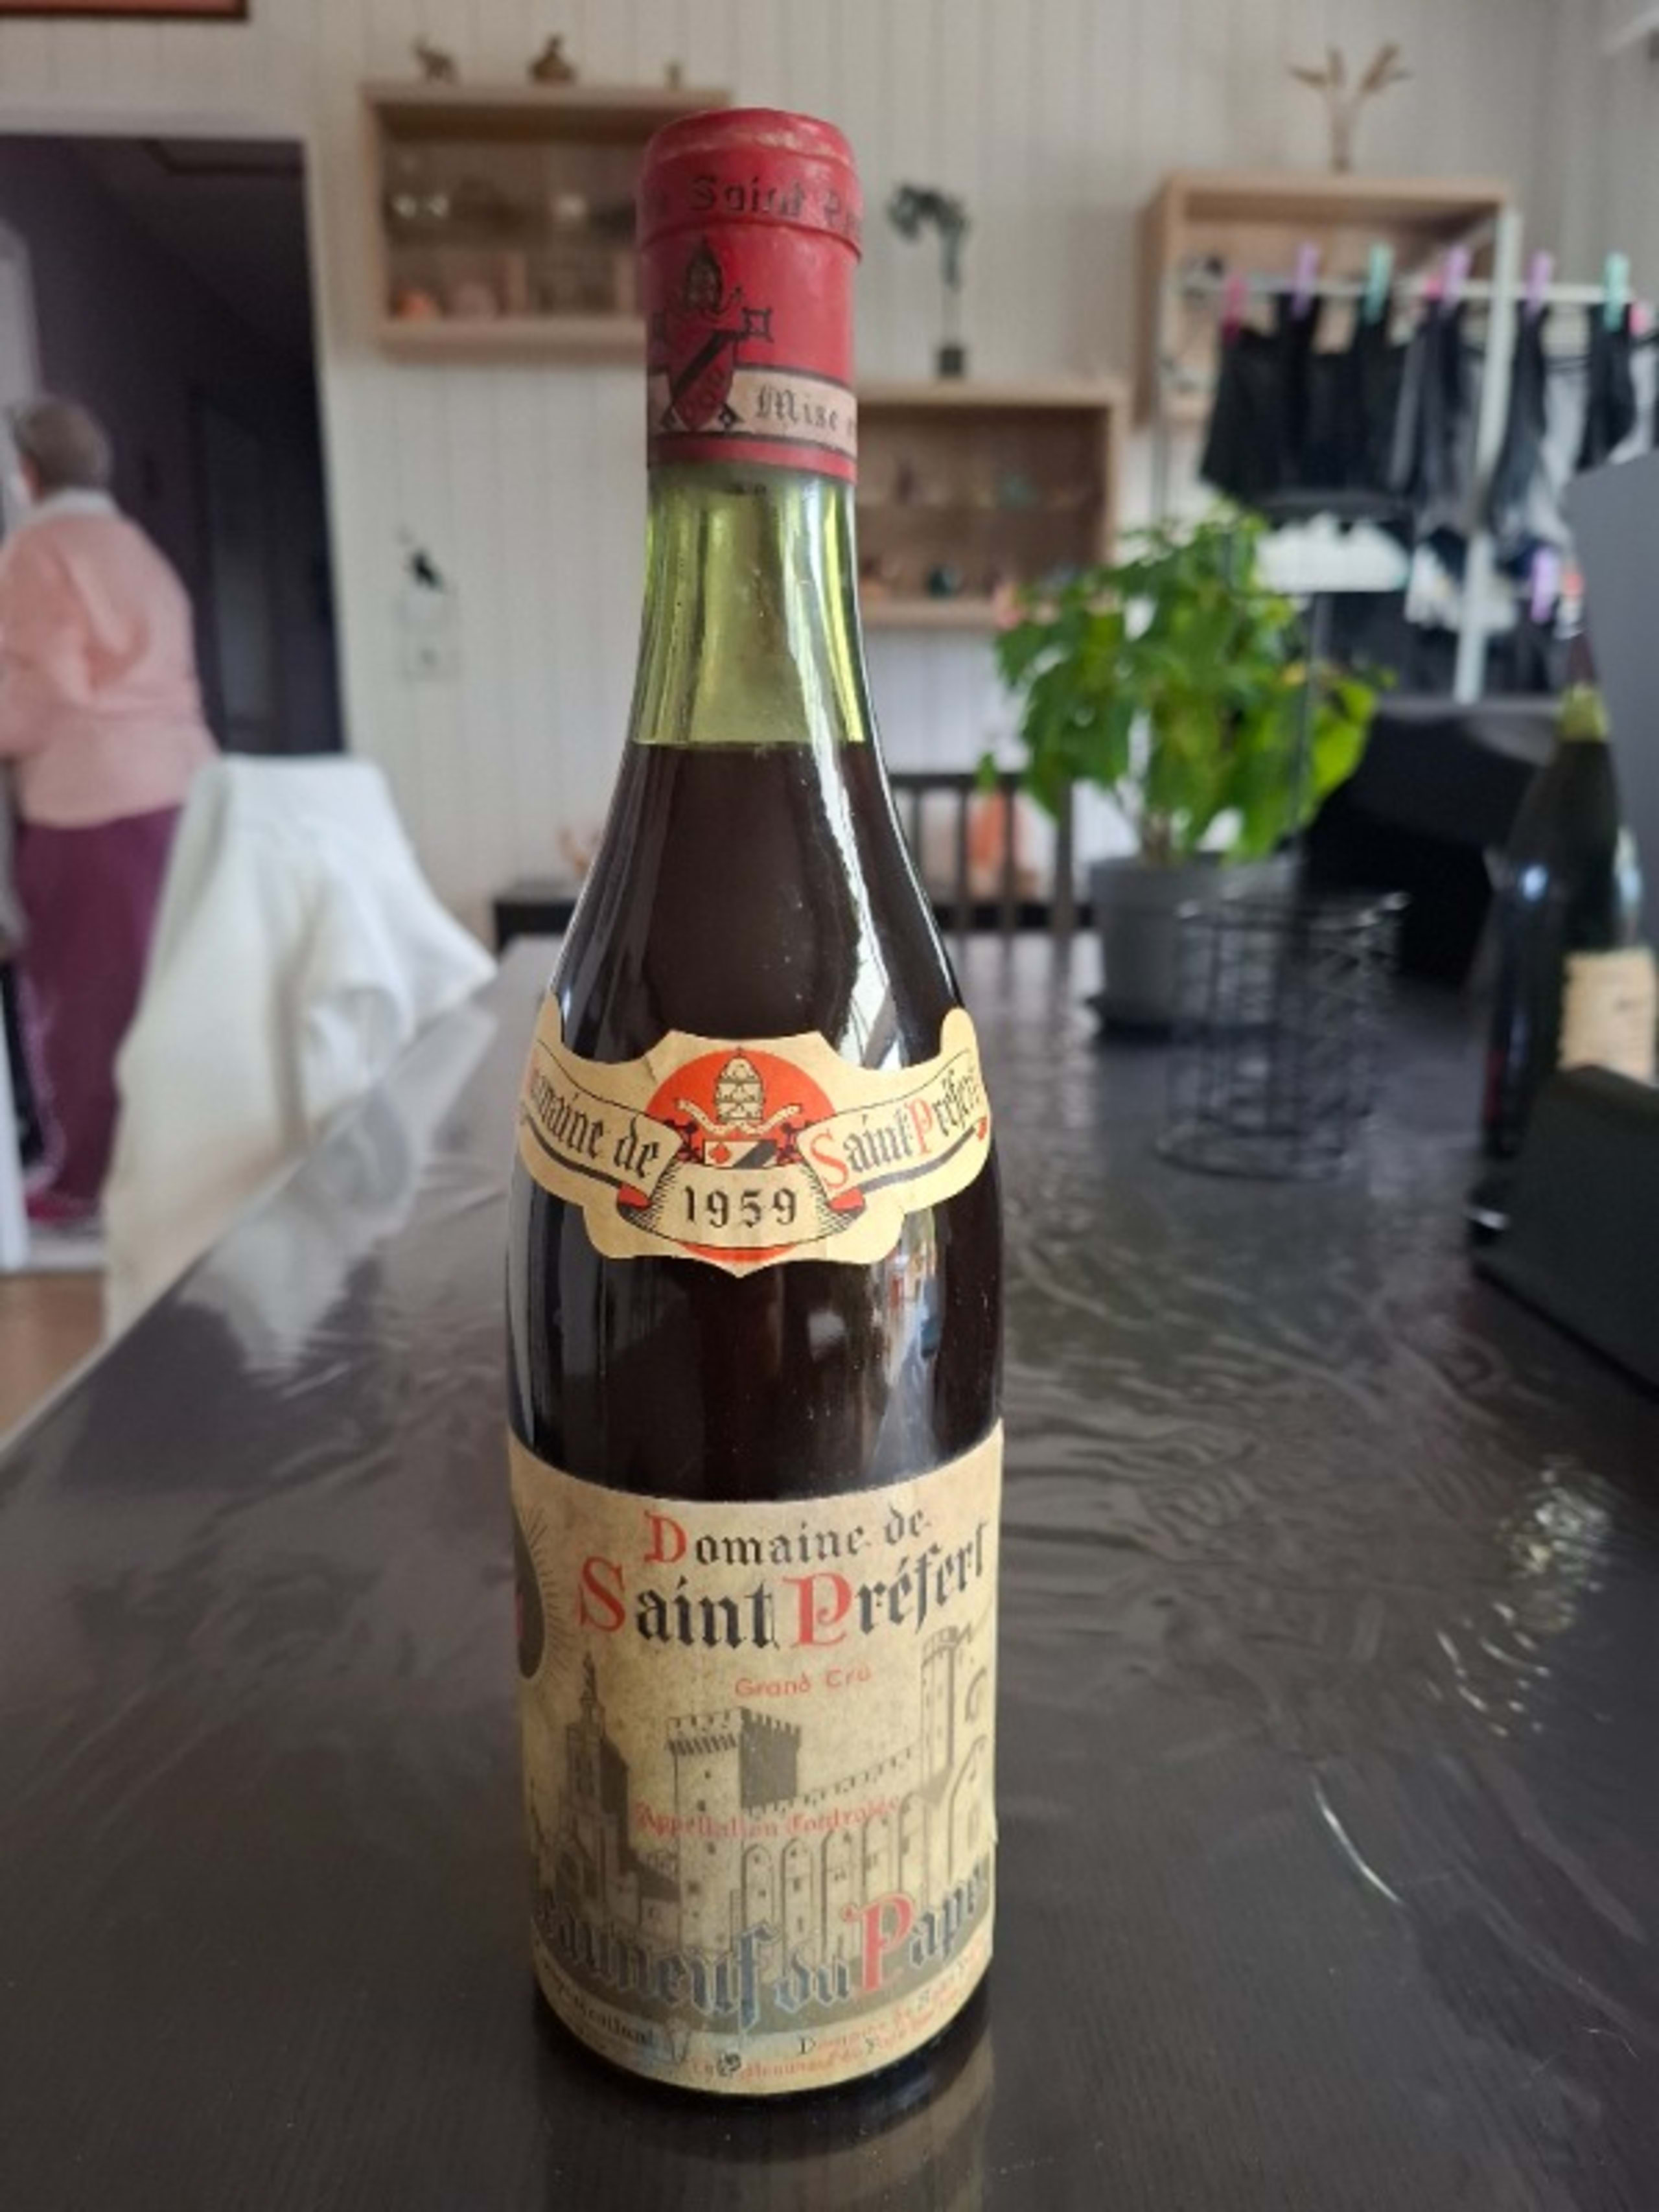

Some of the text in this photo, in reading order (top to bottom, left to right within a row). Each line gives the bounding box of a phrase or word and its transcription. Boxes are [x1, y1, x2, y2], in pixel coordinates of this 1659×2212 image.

[755, 384, 839, 429] Mise
[613, 1112, 660, 1179] de
[810, 1107, 912, 1191] Saint
[682, 1186, 798, 1229] 1959
[644, 1502, 932, 1566] Domaine de
[576, 1555, 780, 1649] Saint
[734, 1672, 811, 1697] Grand
[772, 1946, 851, 2013] du
